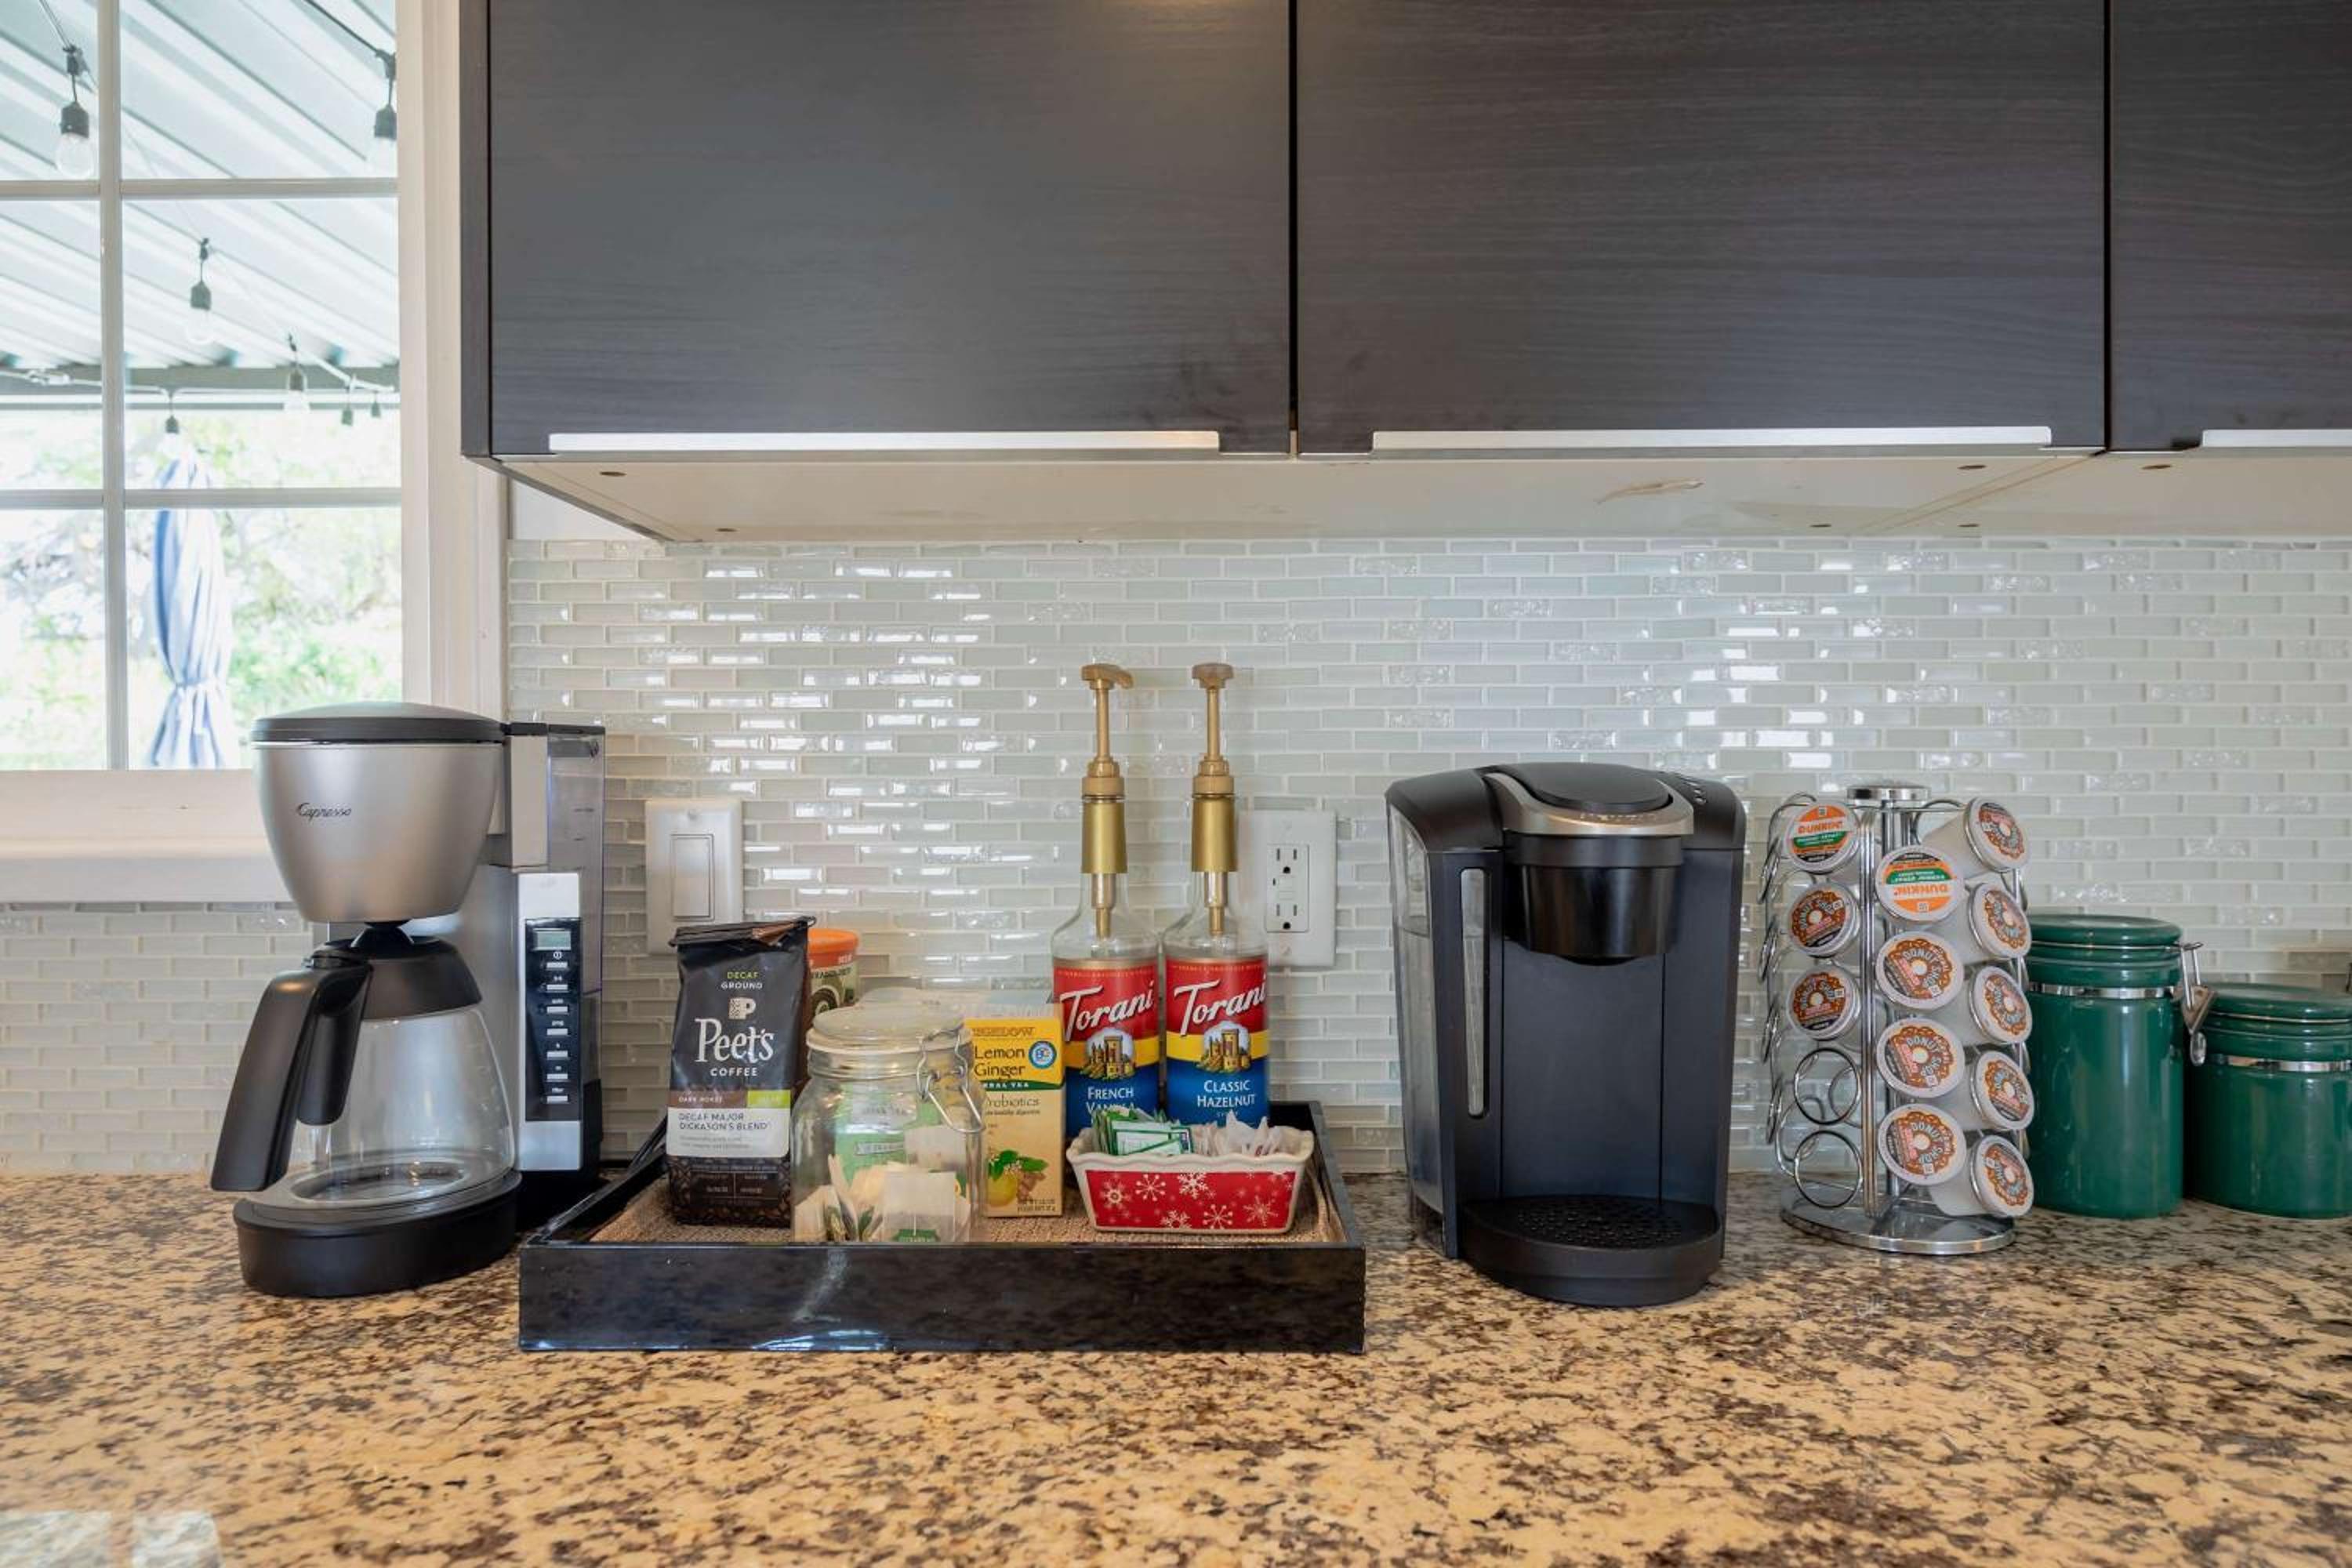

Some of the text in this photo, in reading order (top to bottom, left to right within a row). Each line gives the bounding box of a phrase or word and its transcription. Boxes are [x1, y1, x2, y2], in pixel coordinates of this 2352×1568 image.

[297, 802, 352, 822] Capresso
[1059, 980, 1155, 1043] Torani
[1174, 975, 1266, 1037] Torani
[694, 1017, 775, 1064] Peet's
[974, 1045, 1025, 1059] Lemon
[710, 1067, 758, 1076] COFFEE
[974, 1062, 1025, 1079] Ginger
[1087, 1085, 1134, 1100] FRENCH
[1203, 1080, 1251, 1093] CLASSIC
[1197, 1094, 1256, 1108] HAZELNUT
